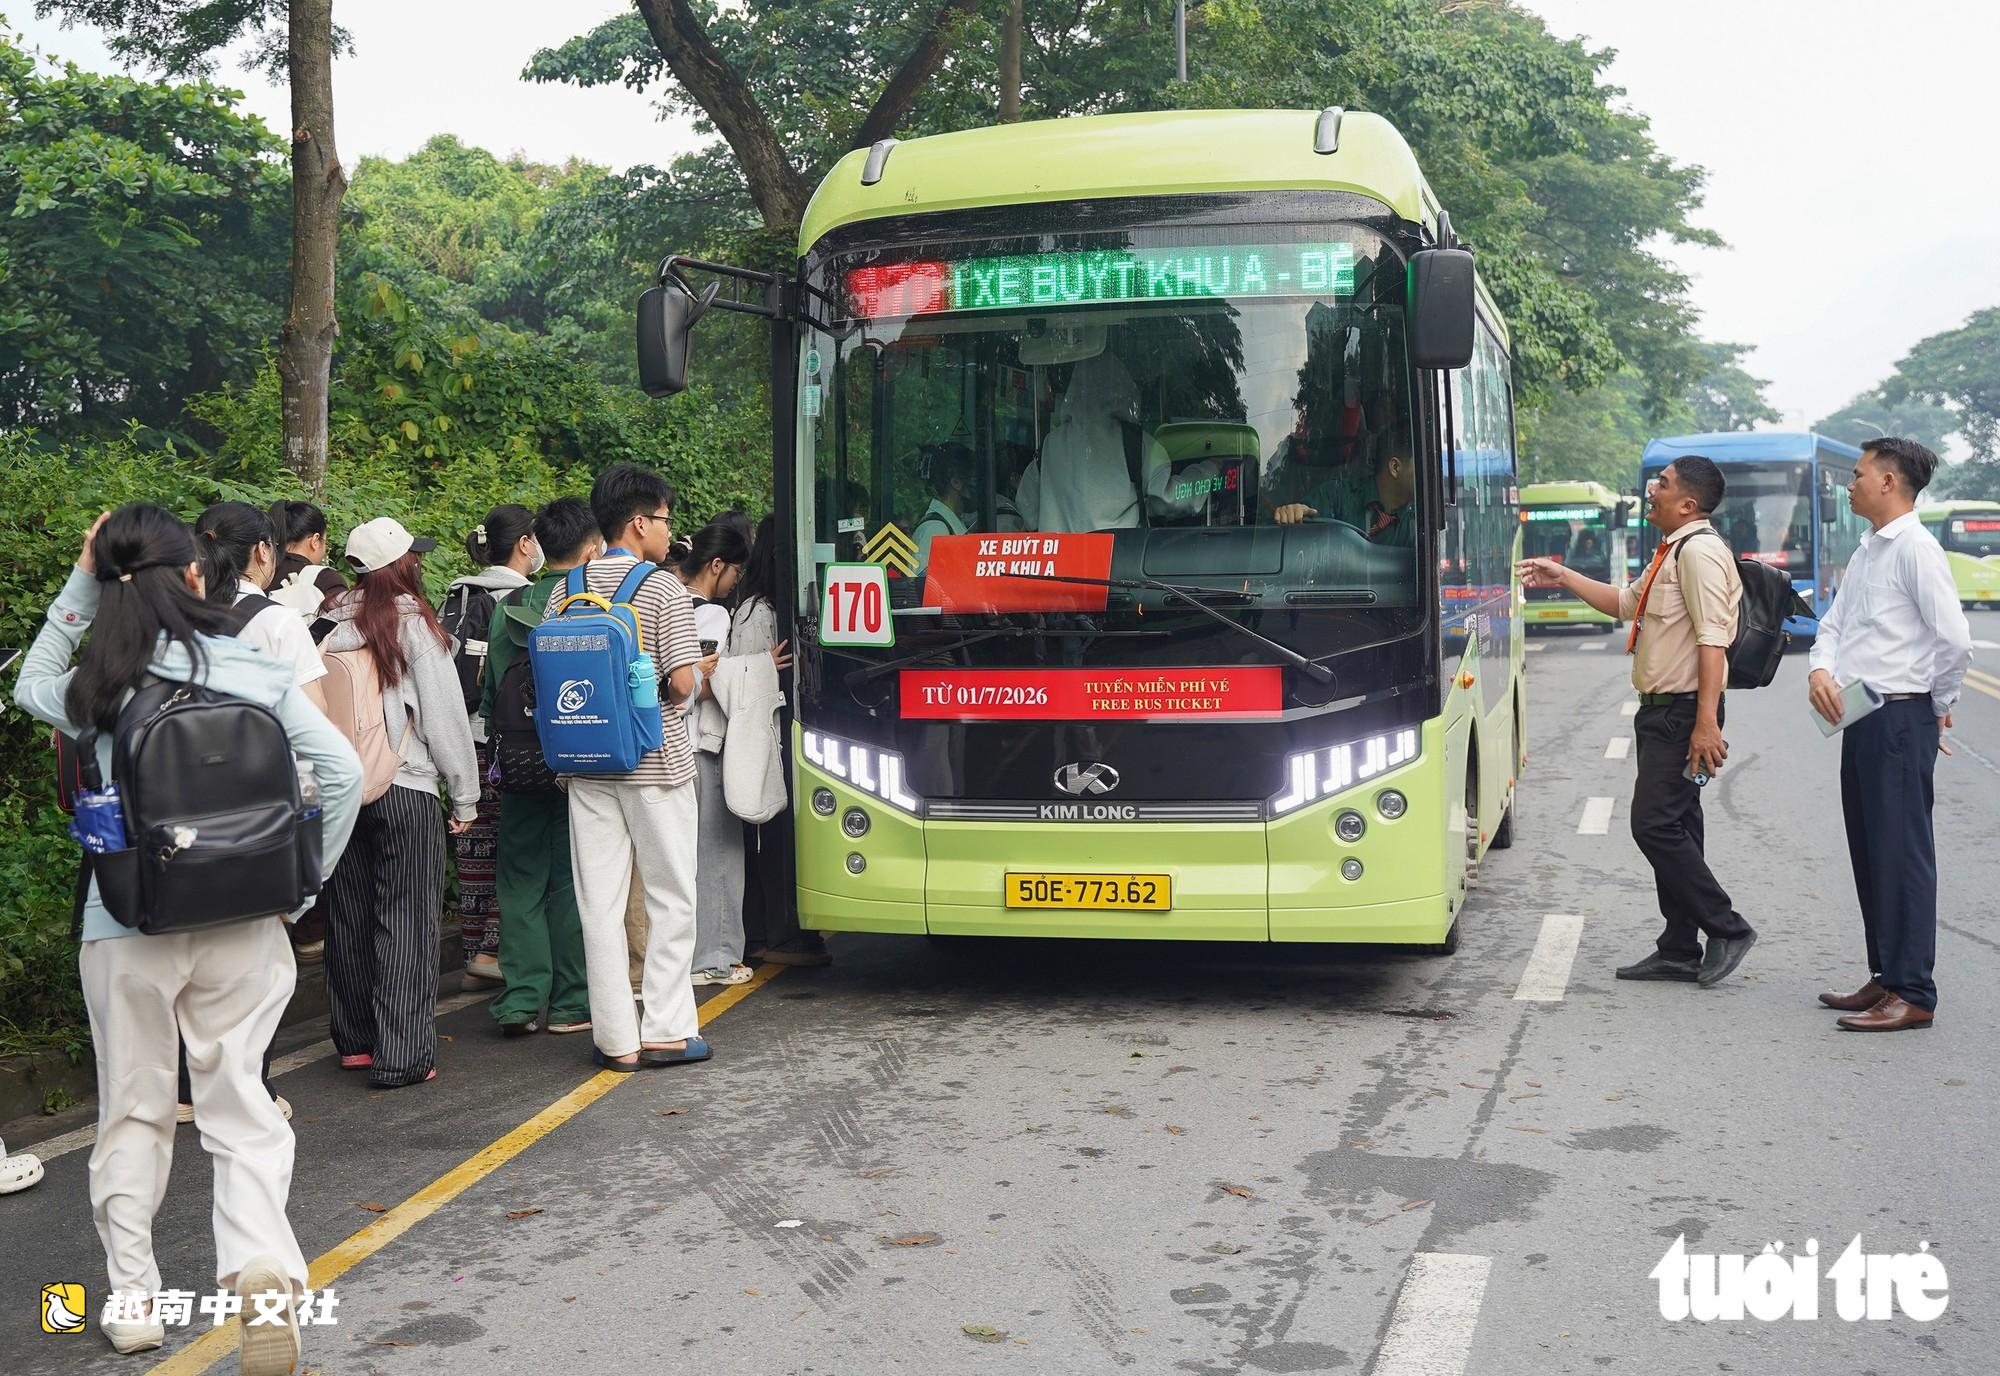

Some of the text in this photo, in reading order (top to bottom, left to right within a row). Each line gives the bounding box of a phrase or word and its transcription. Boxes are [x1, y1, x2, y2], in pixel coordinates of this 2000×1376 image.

[974, 267, 1020, 306] XE
[1032, 253, 1135, 302] BUÝT
[1148, 256, 1230, 297] KHU
[1242, 253, 1267, 292] A
[978, 537, 1059, 555] XE BUÝT ĐI
[1010, 561, 1041, 575] KHU
[1044, 561, 1055, 576] A
[828, 582, 882, 633] 170
[922, 682, 1048, 705] TỪ 01/7/2026
[1084, 676, 1230, 693] TUYẾN MIỄN PHÍ VÉ
[1092, 697, 1222, 710] FREE BUS TICKET
[1040, 805, 1136, 820] KIM LONG
[1019, 880, 1156, 904] 50E-773.62
